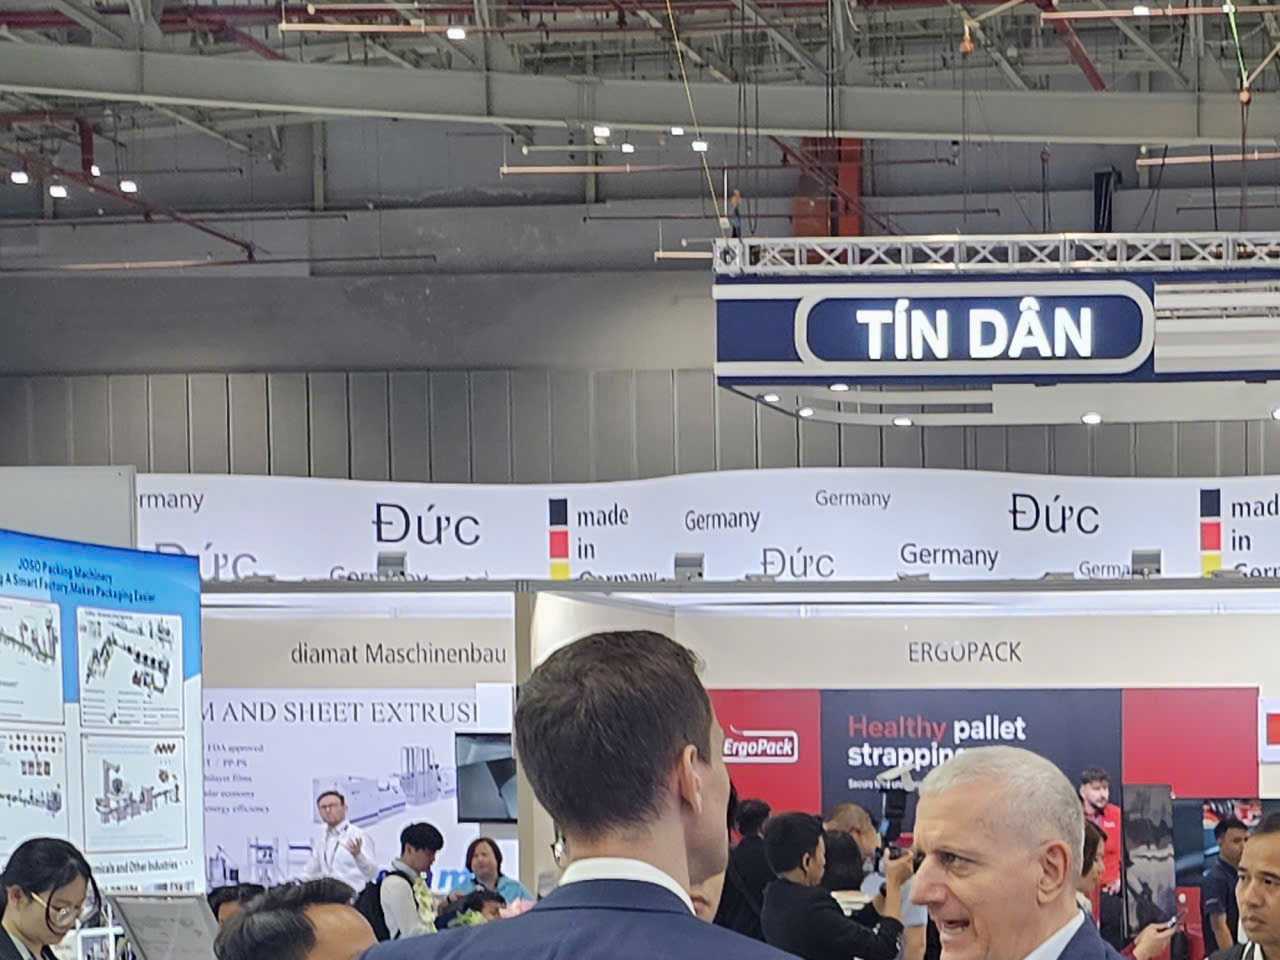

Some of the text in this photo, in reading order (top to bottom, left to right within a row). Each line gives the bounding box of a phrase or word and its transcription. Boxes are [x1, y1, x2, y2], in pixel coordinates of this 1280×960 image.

[857, 296, 1092, 360] TÍN DÂN
[138, 492, 204, 514] rmany
[815, 489, 892, 510] Germany
[371, 502, 481, 546] Đức
[577, 503, 630, 528] made
[684, 510, 761, 533] Germany
[1008, 492, 1100, 535] Đức
[577, 538, 596, 560] in
[1231, 530, 1251, 552] in
[760, 546, 836, 578] Đức
[899, 543, 999, 571] Germany
[18, 558, 113, 584] JOSO Packing Machinery
[1078, 560, 1131, 578] Germa
[13, 574, 38, 588] Smart
[71, 582, 95, 597] Makes
[96, 586, 133, 603] Packaging
[291, 642, 507, 664] diamat Maschinenbau
[908, 641, 1022, 663] ERGOPACK
[223, 702, 277, 722] AND
[283, 702, 364, 723] SHEET
[371, 701, 477, 723] EXTRUSI
[848, 715, 1027, 744] Healthy pallet
[723, 738, 794, 758] ErgoPack
